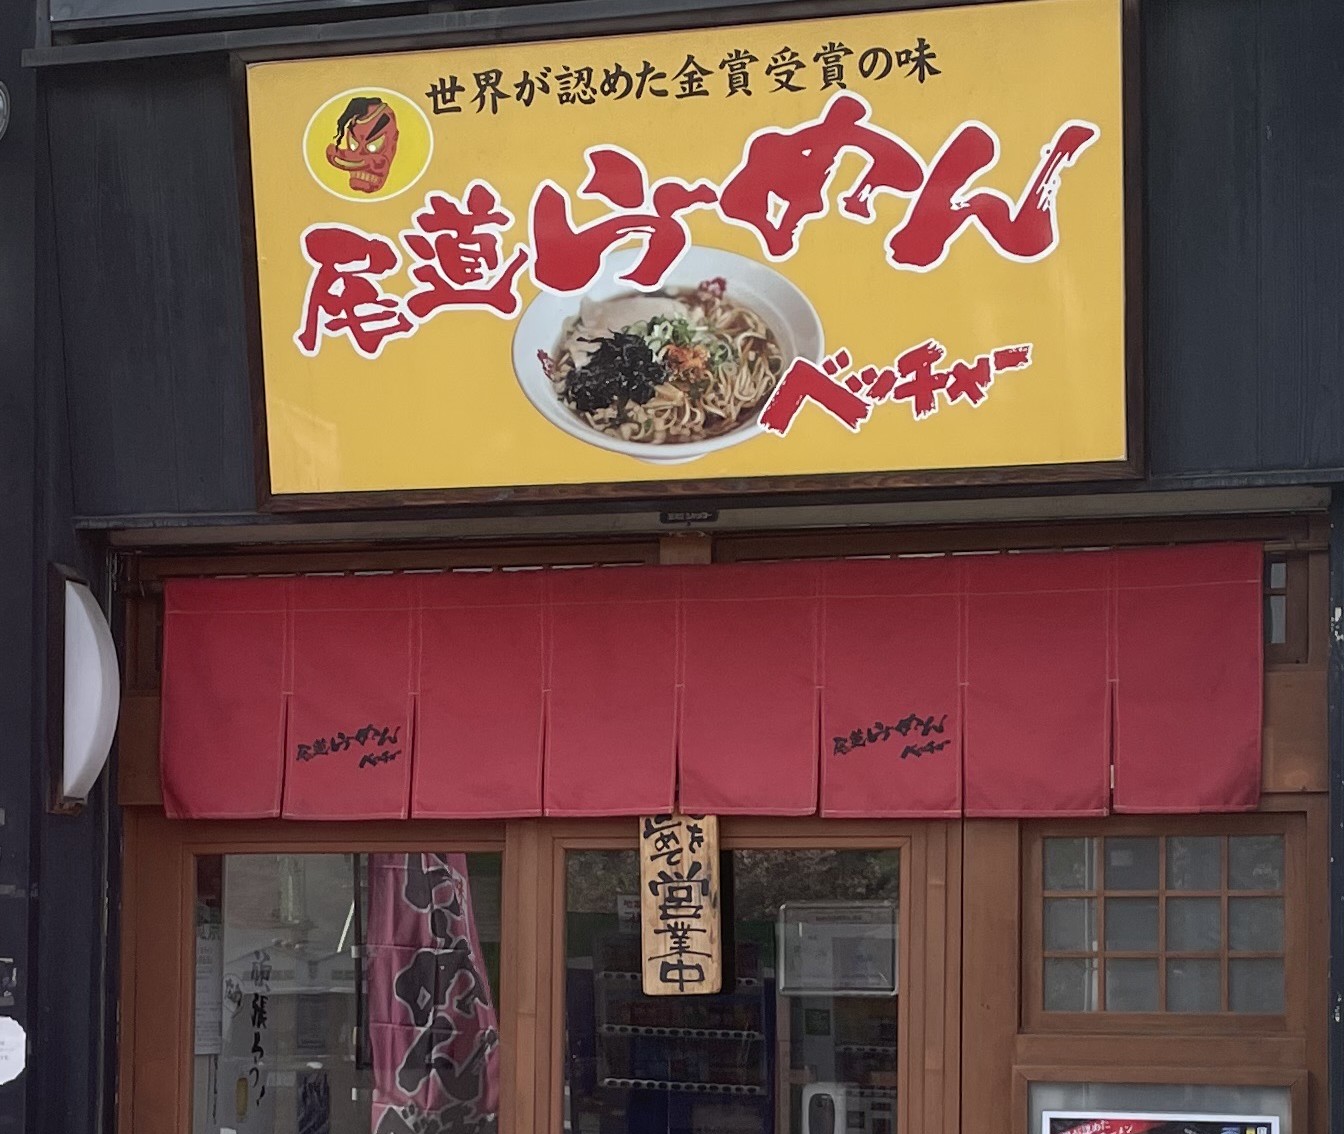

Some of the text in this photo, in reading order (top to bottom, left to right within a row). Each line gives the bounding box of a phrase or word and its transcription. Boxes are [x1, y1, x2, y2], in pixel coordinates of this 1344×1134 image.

[425, 37, 942, 115] 世界が認めた金賞受賞の味
[294, 90, 1100, 359] 尾道らーめん
[756, 340, 1033, 437] ベッチャー
[296, 723, 401, 761] 尾道らーめん
[832, 713, 949, 756] 尾道らーめん
[647, 861, 712, 992] 営業中
